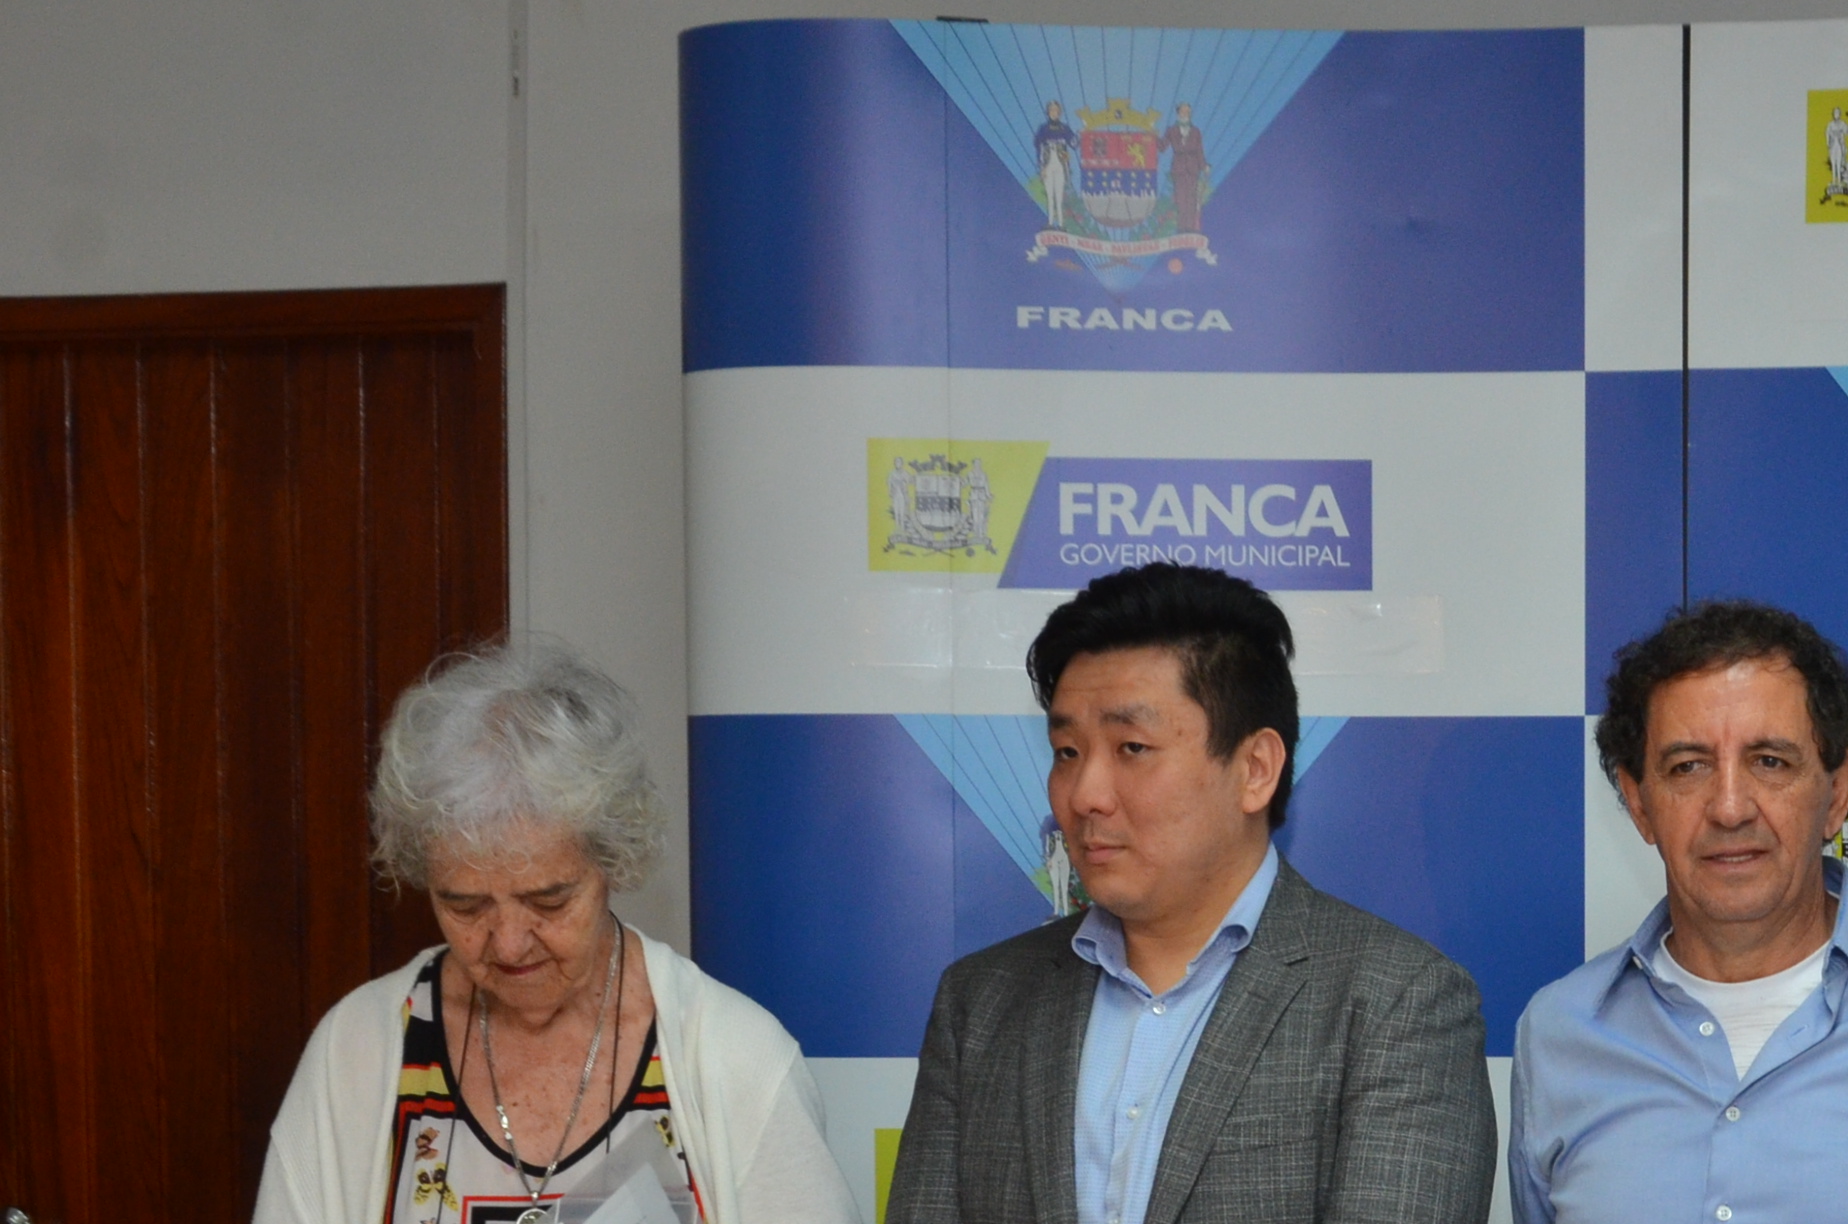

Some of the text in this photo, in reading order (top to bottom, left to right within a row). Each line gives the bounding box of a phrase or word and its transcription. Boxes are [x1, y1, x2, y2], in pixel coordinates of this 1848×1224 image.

[1017, 305, 1233, 332] FRANCA
[1058, 482, 1350, 537] FRANCA
[1060, 542, 1350, 567] GOVERNO MUNICIPAL
